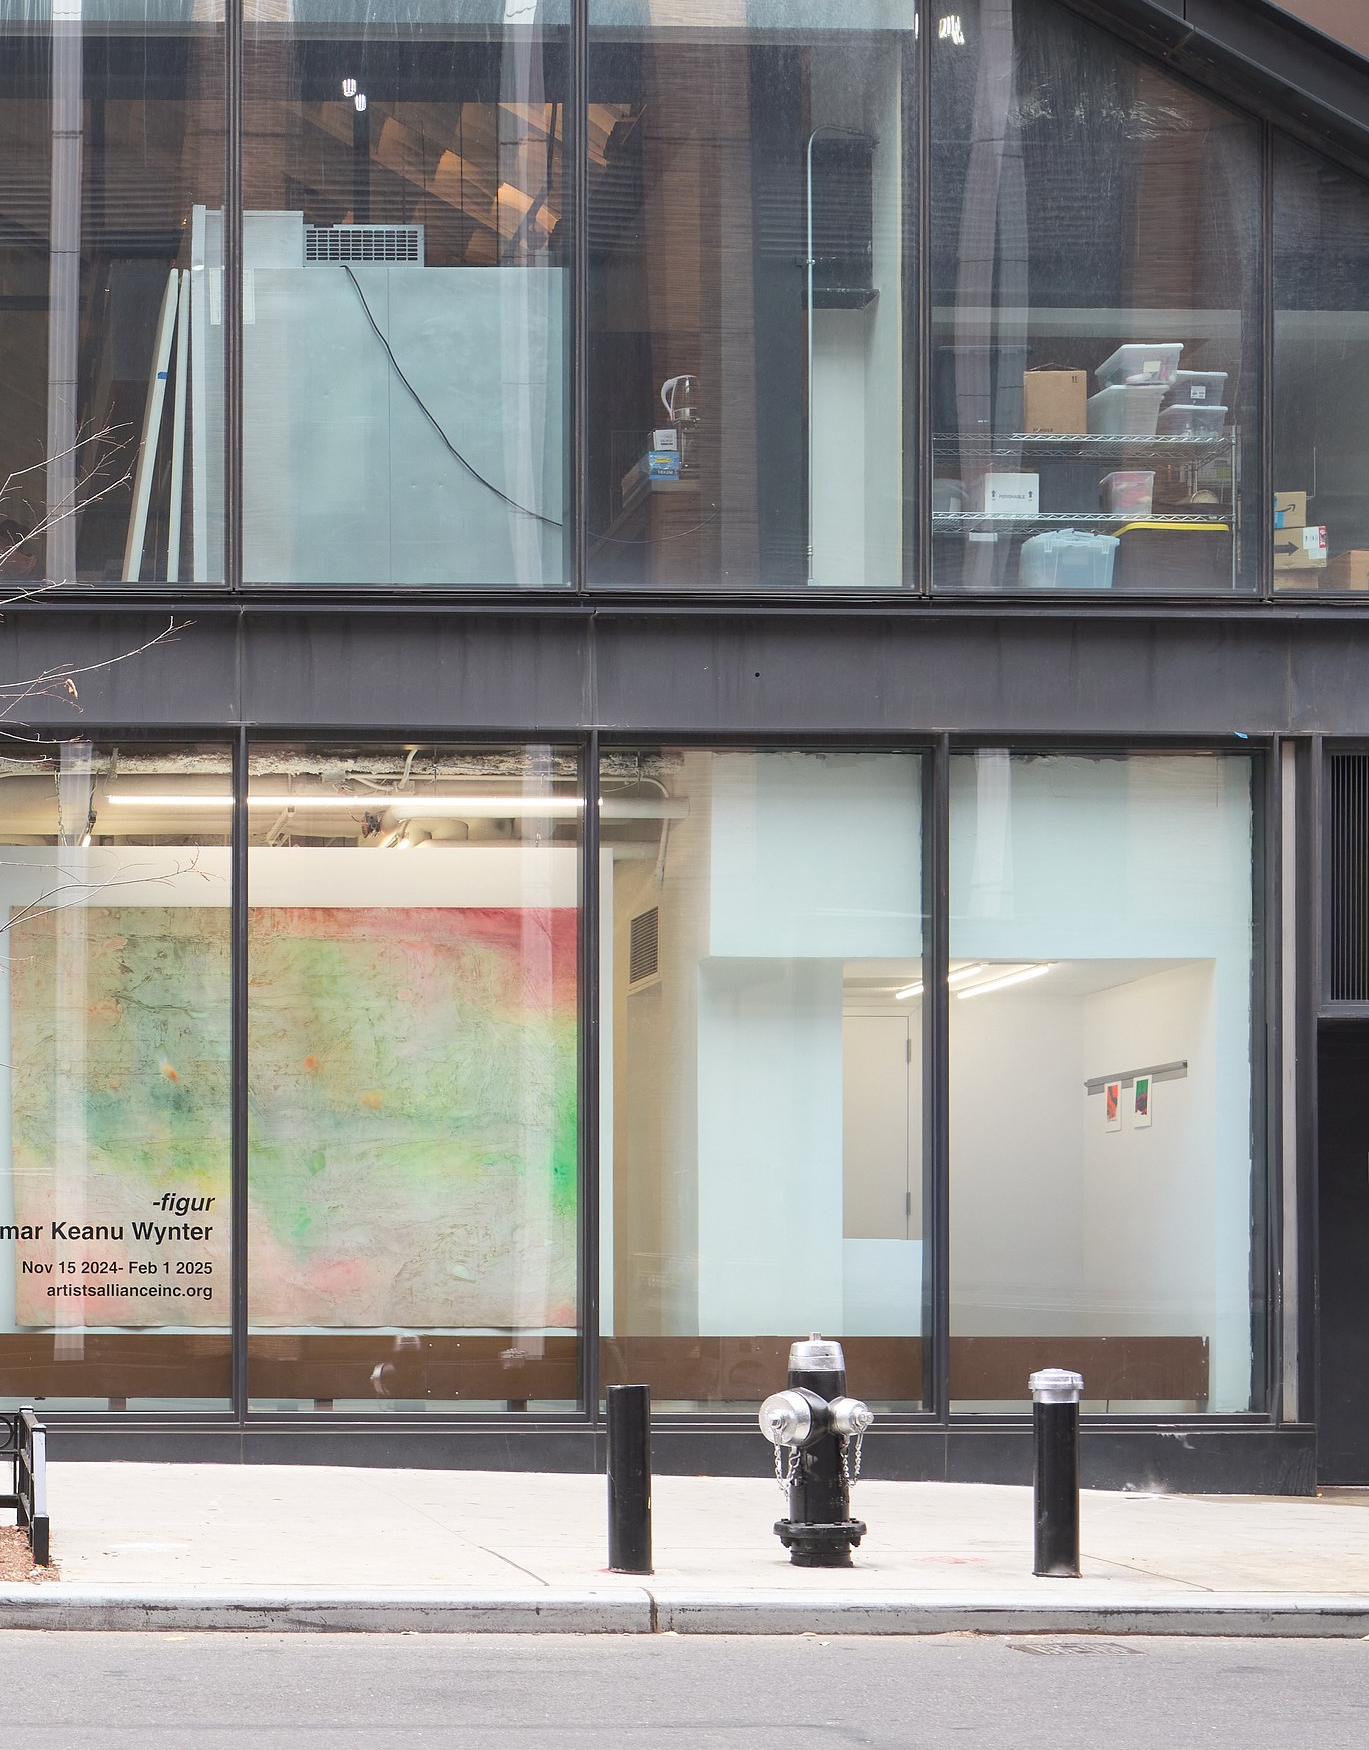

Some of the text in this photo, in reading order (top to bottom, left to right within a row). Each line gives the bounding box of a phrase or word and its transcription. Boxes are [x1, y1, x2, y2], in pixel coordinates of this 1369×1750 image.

[152, 1192, 216, 1216] -figur
[51, 1221, 124, 1241] Keanu
[131, 1221, 213, 1245] Wynter
[22, 1260, 213, 1274] Nov 15 2024- Feb 1 2025
[46, 1283, 213, 1300] artistsallianceinc.org
